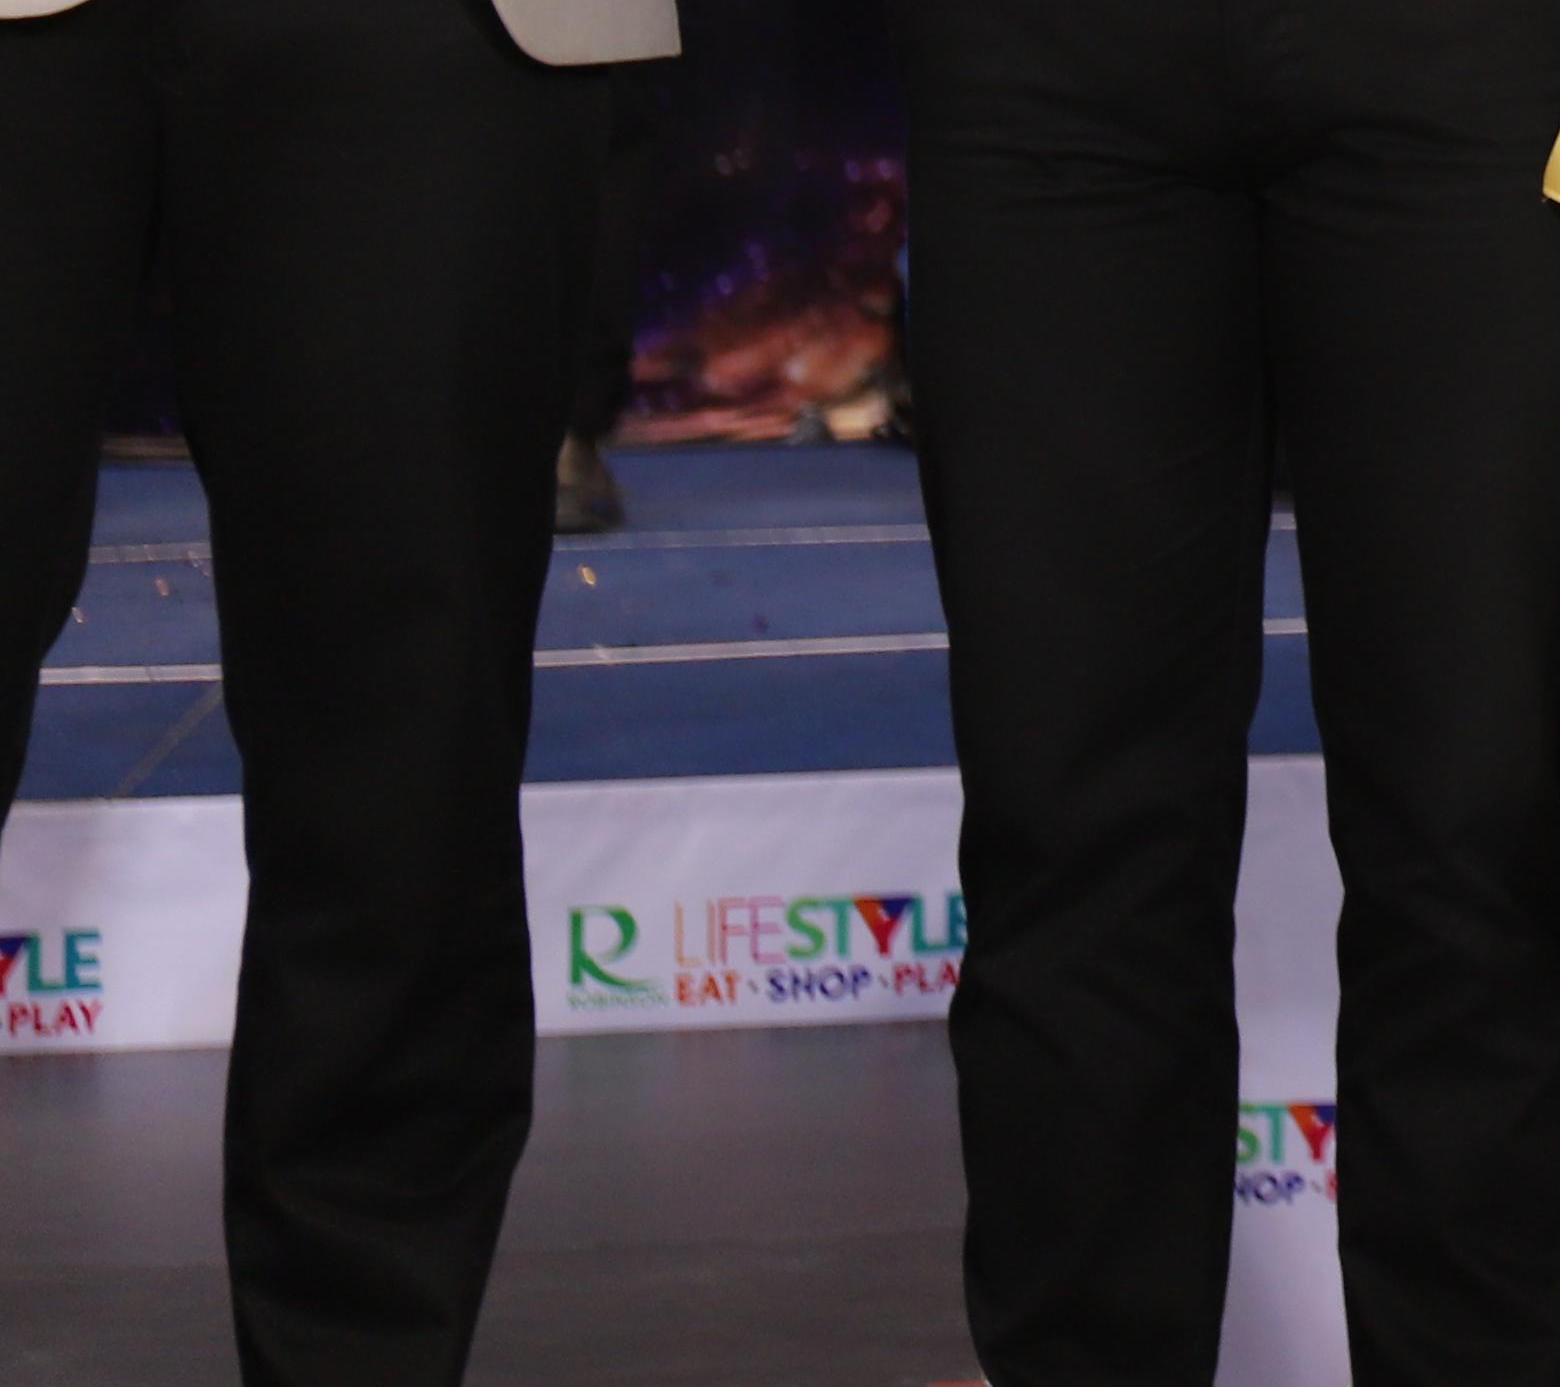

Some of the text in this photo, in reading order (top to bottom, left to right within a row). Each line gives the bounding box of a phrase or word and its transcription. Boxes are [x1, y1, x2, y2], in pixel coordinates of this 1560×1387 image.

[674, 960, 961, 1007] EAT SHOP PLA
[7, 1000, 103, 1038] PLAY
[1237, 1172, 1306, 1205] HOP
